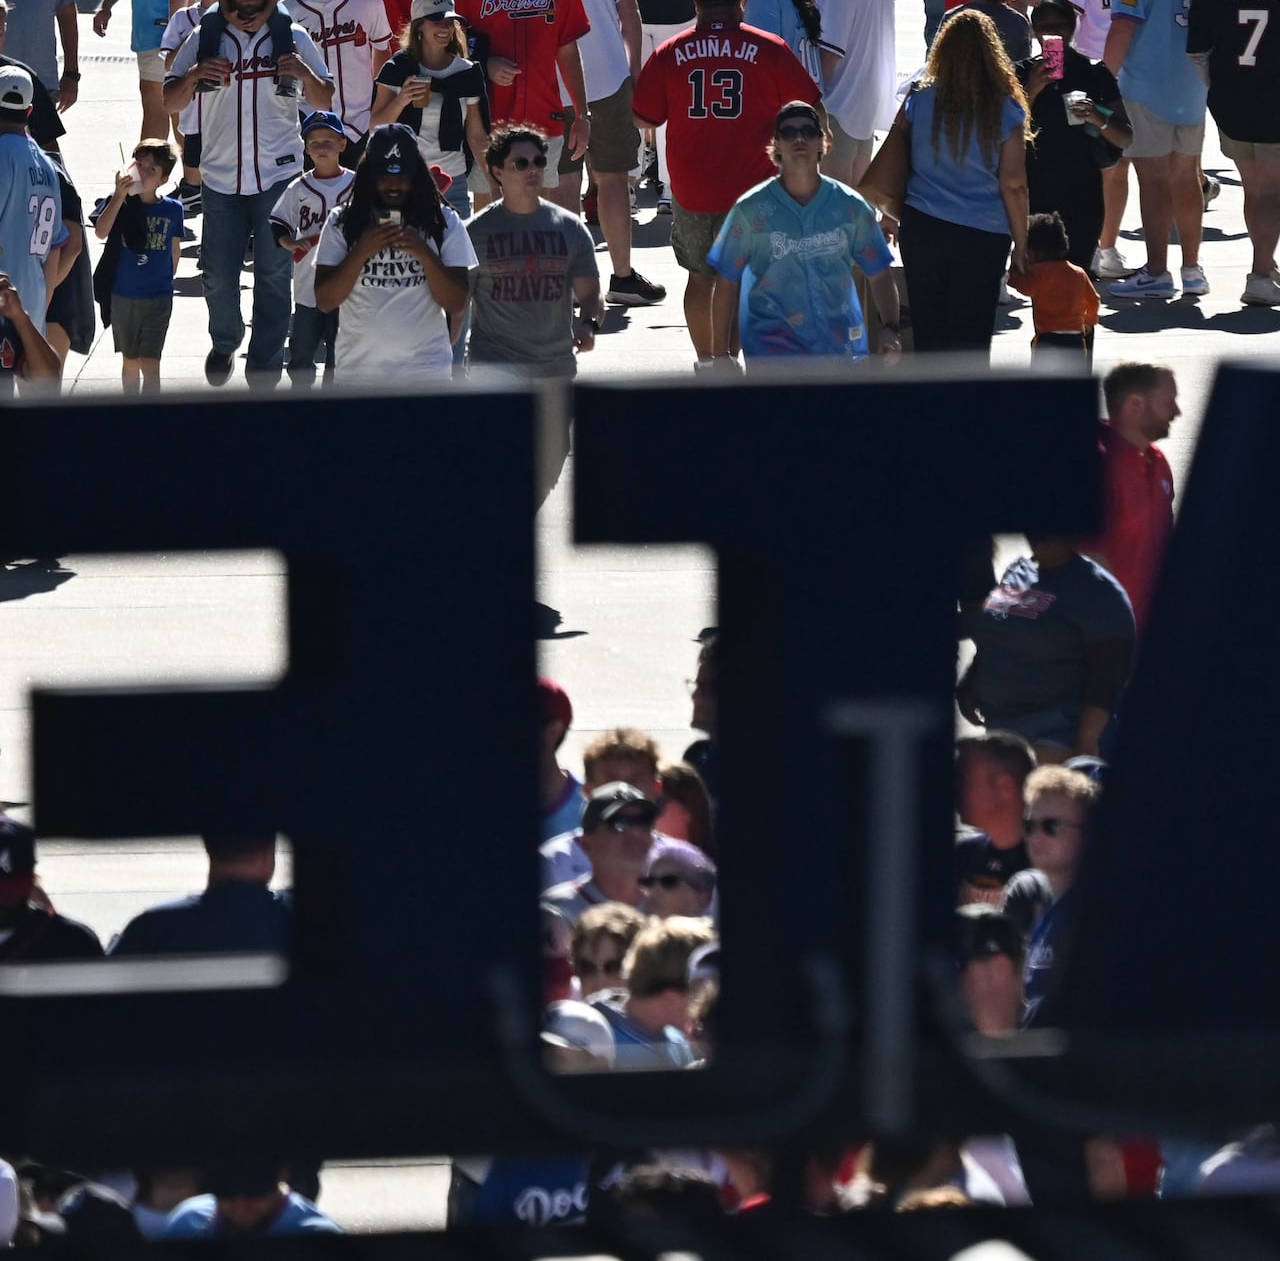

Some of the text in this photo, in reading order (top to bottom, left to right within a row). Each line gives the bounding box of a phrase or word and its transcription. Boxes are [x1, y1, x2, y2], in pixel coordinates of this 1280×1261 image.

[308, 19, 356, 43] raves
[1238, 9, 1270, 67] 7
[675, 35, 758, 66] ACUÑA JR.
[688, 68, 743, 119] 13
[384, 142, 401, 160] A
[487, 230, 569, 260] ATLANTA
[361, 258, 424, 277] rave
[491, 274, 564, 303] BRAVES
